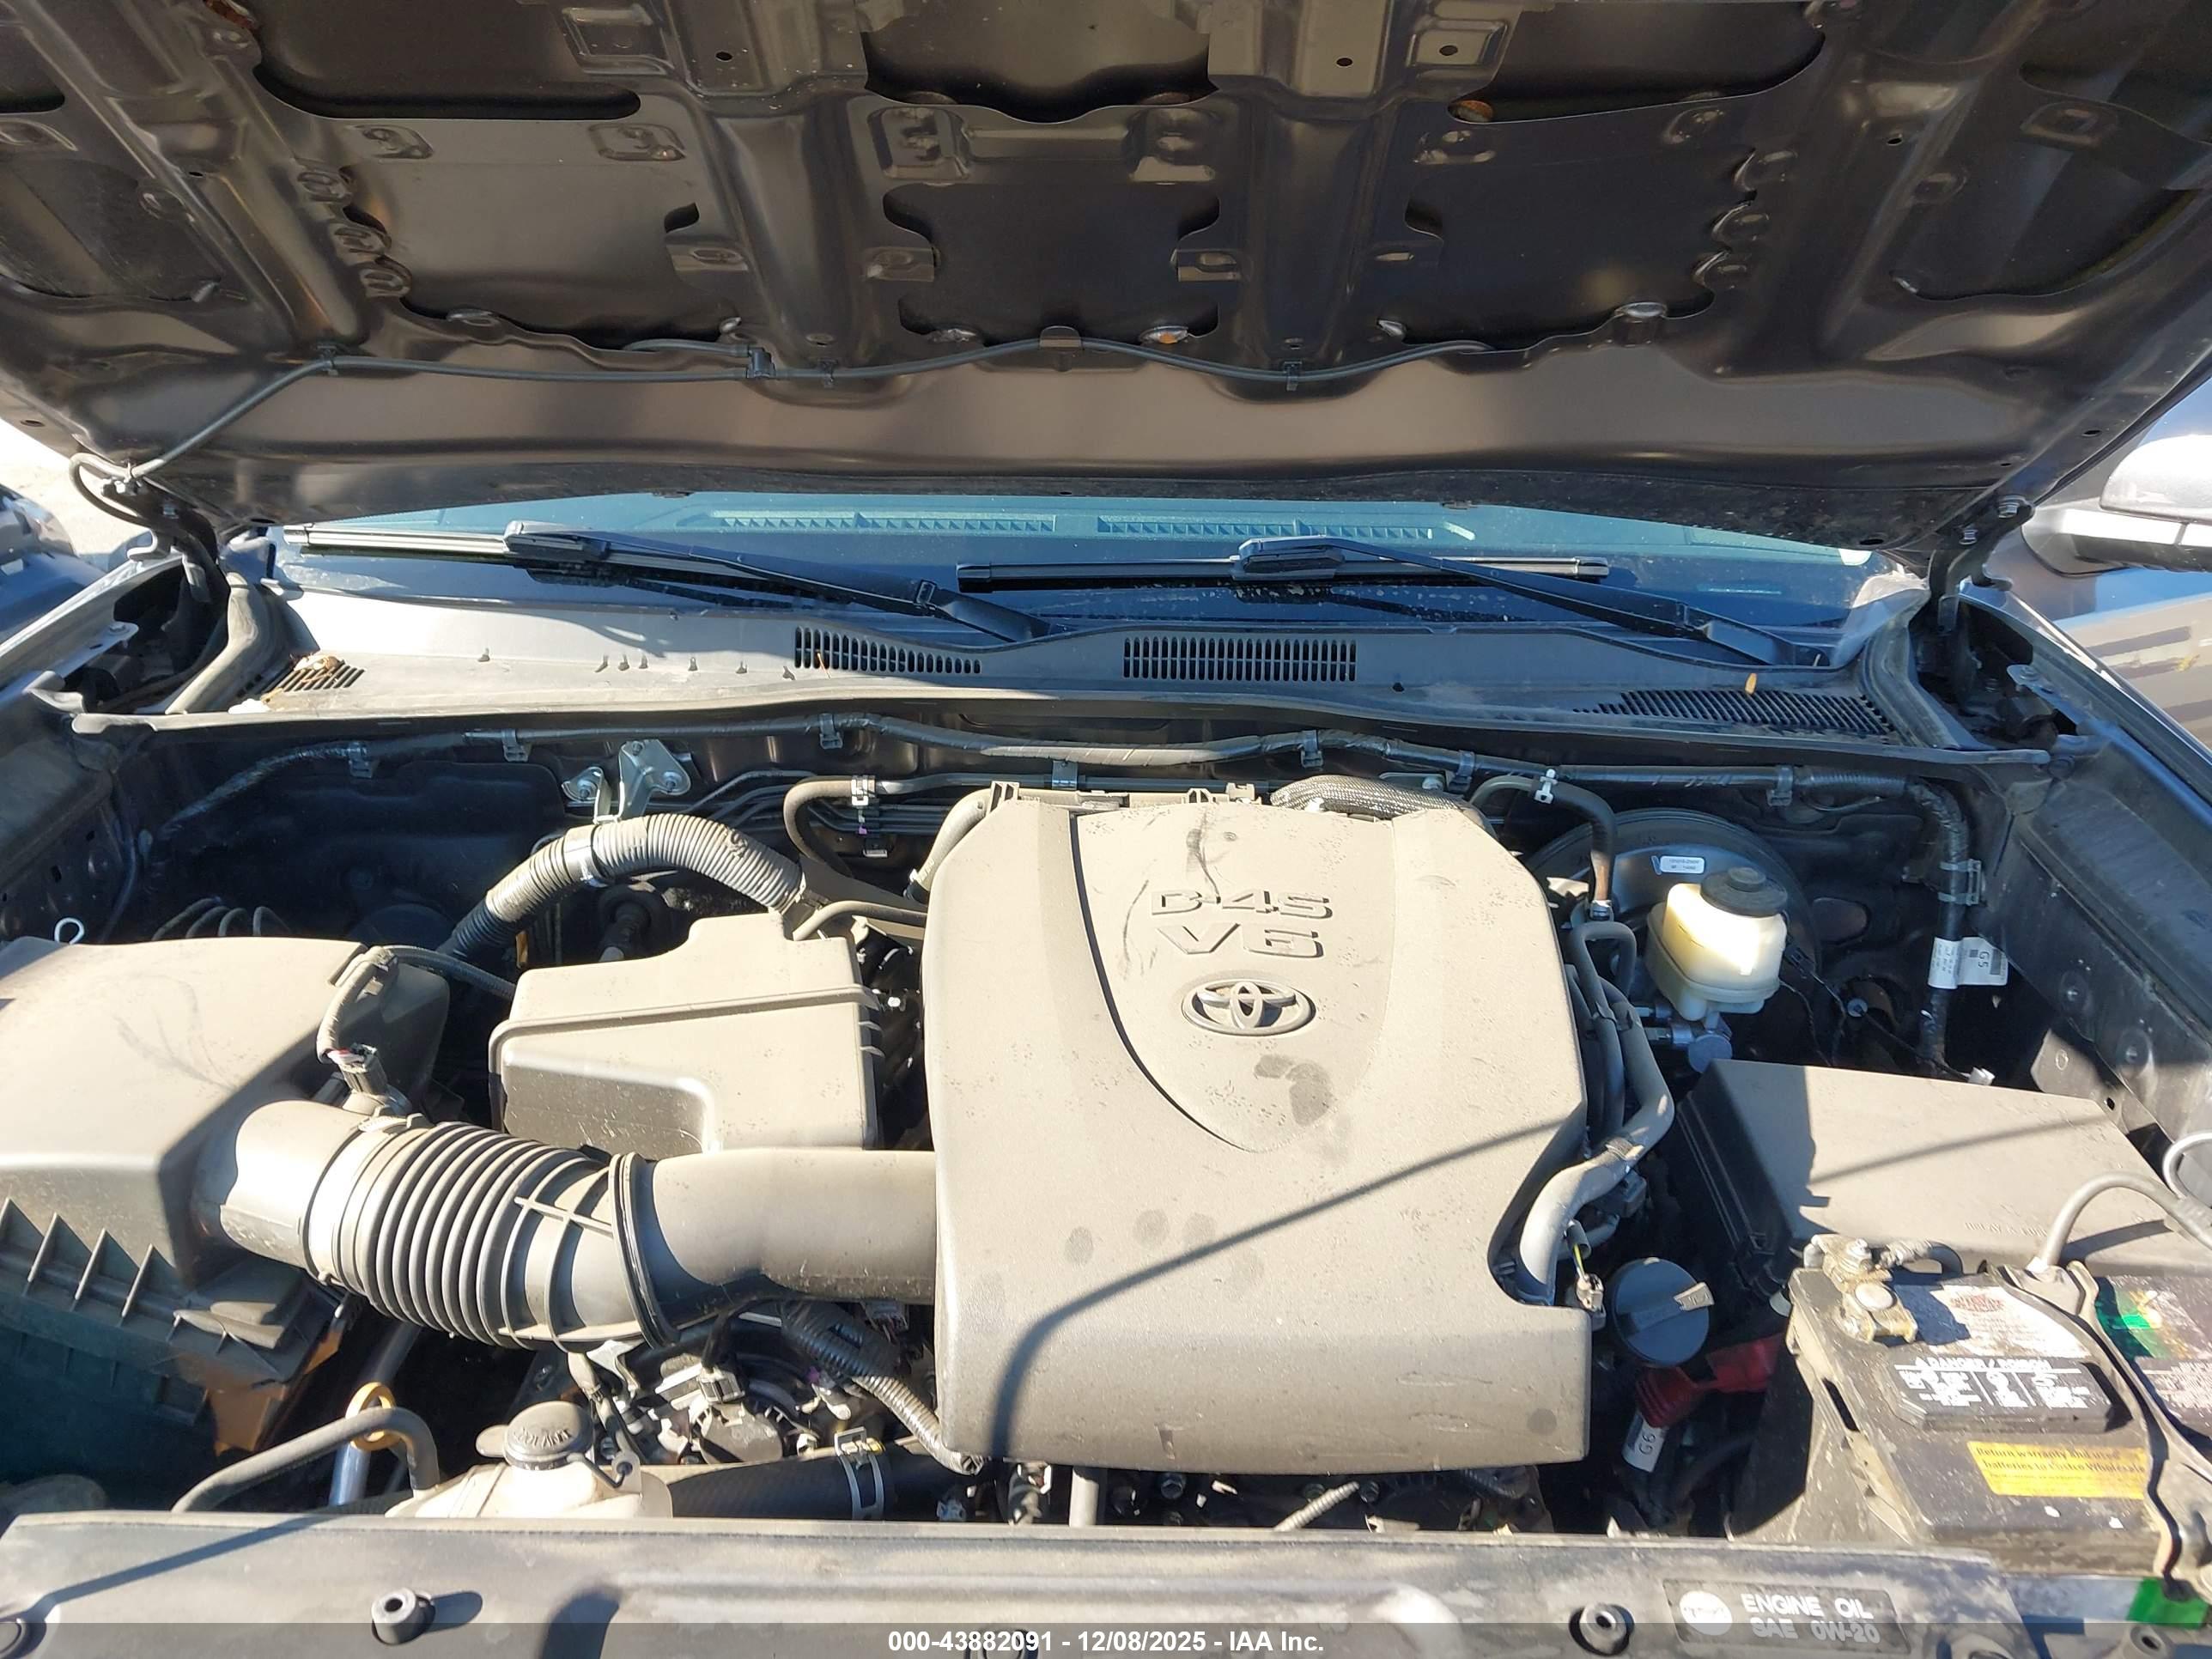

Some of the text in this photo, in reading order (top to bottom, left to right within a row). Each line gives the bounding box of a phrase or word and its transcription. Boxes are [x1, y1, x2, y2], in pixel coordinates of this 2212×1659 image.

[1157, 922, 1324, 958] V6
[1740, 1593, 1825, 1618] ENGINE
[1834, 1598, 1874, 1620] OIL
[1749, 1617, 1881, 1644] SAE 0W-20
